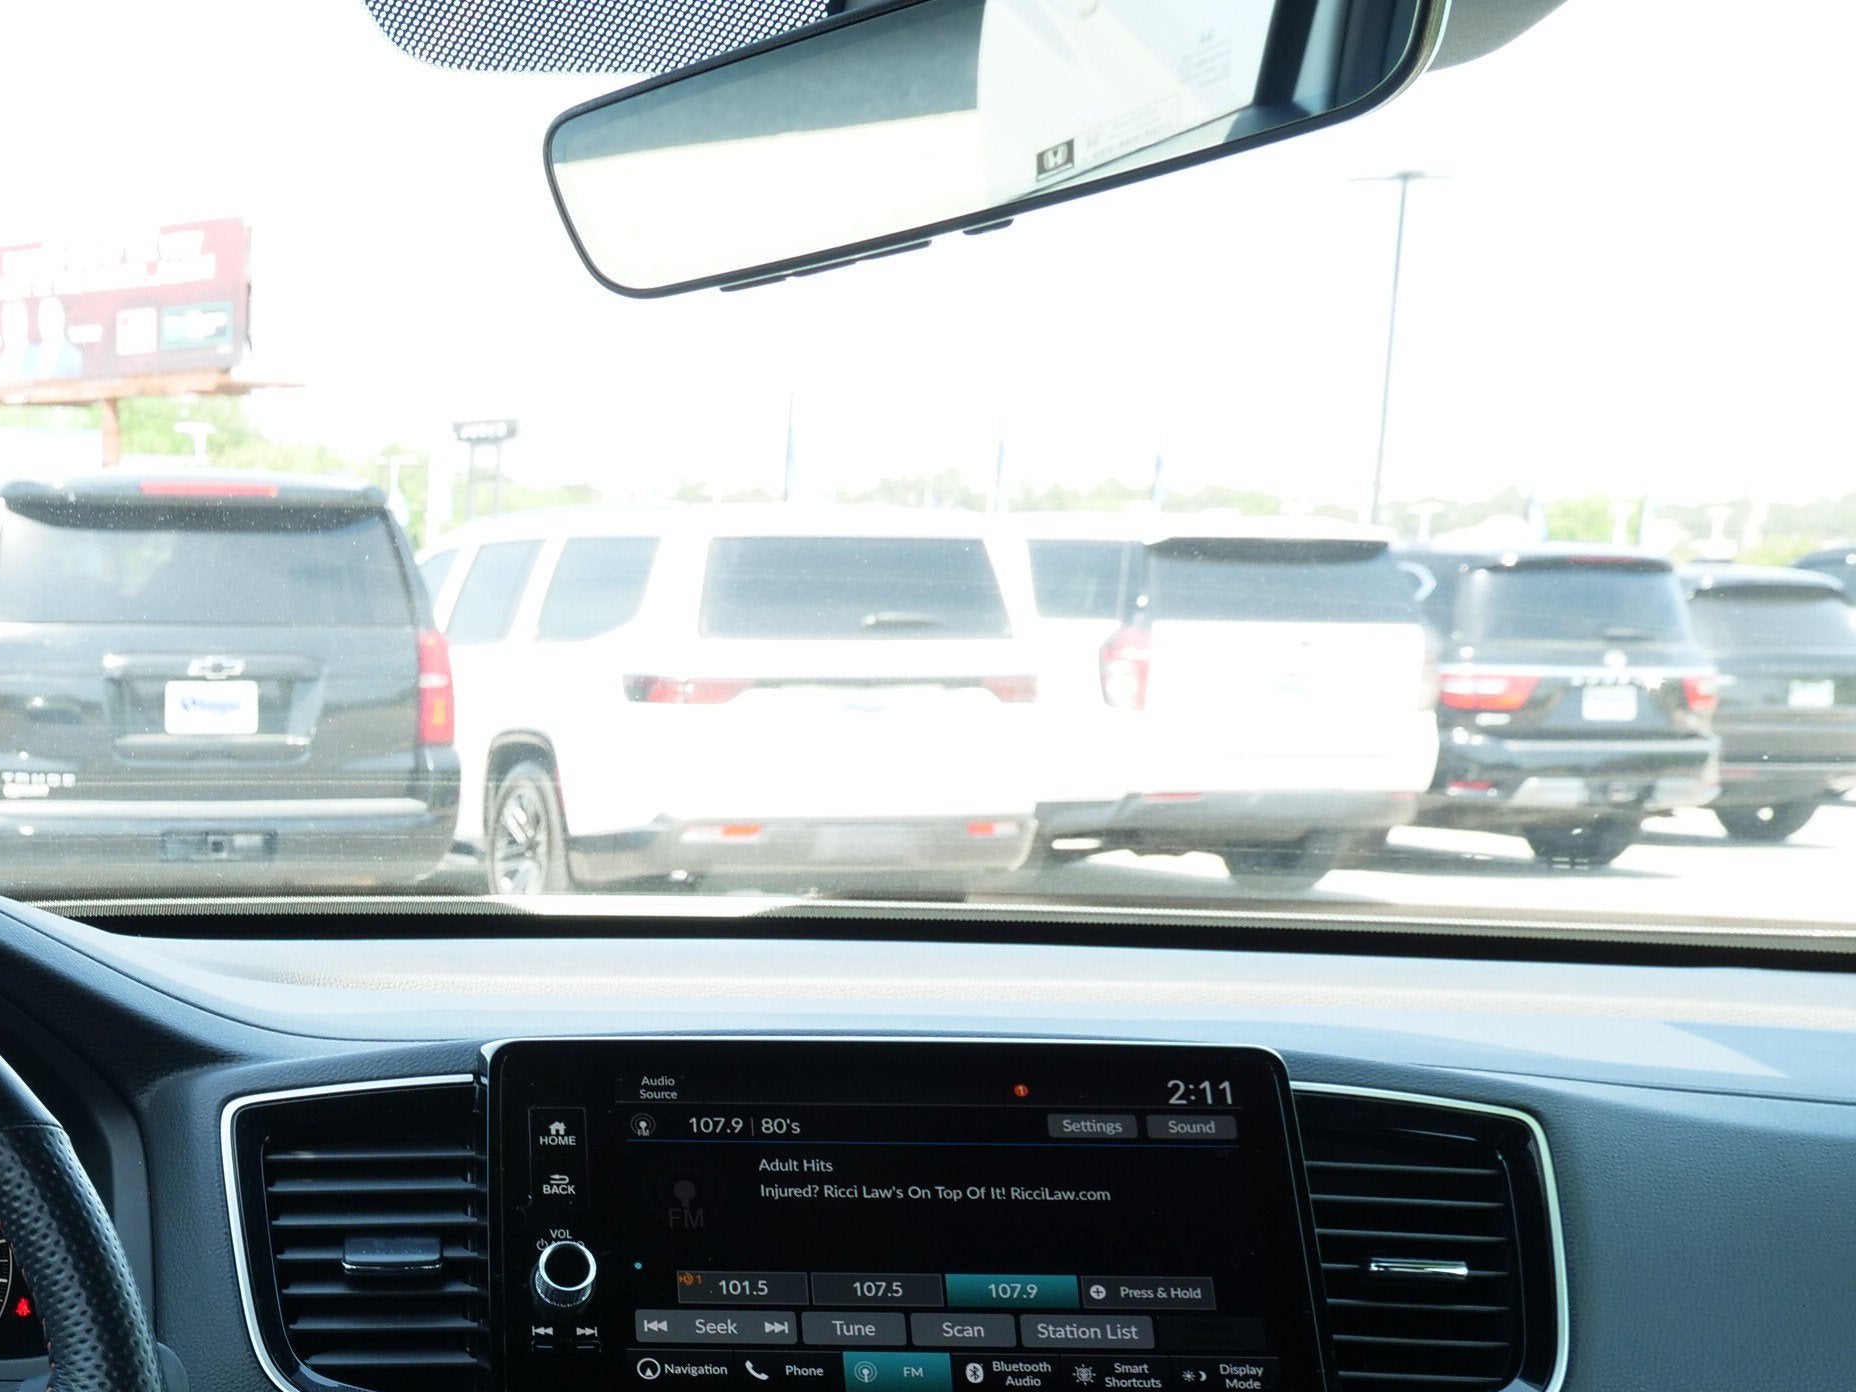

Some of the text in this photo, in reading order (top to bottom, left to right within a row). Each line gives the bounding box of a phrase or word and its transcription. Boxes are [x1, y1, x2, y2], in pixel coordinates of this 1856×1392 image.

[641, 1076, 675, 1087] Audio
[639, 1089, 678, 1100] Source
[1167, 1079, 1233, 1105] 2:11
[688, 1118, 801, 1134] 107.9 80's
[1062, 1119, 1123, 1135] Settings
[1168, 1119, 1215, 1135] Sound
[539, 1136, 576, 1146] HOME
[758, 1159, 833, 1173] Adult Hits
[543, 1185, 576, 1195] BACK
[760, 1184, 1111, 1203] Injured? Ricci Law's On Top Of It! RicciLaw.com
[669, 1209, 705, 1228] FM
[549, 1229, 573, 1240] VOL
[718, 1280, 769, 1296] 101.5
[853, 1282, 903, 1297] 107.5
[987, 1283, 1038, 1299] 107.9
[1120, 1286, 1202, 1299] Press & Hold
[695, 1318, 738, 1335] Seek
[831, 1320, 876, 1336] Tune
[942, 1323, 985, 1338] Scan
[1037, 1323, 1139, 1340] Station List
[664, 1363, 728, 1377] Navigation
[785, 1365, 824, 1377] Phone
[903, 1367, 924, 1378] FM
[992, 1361, 1052, 1374] Bluetooth
[1114, 1363, 1149, 1375] Smart
[1219, 1364, 1264, 1379] Display
[1005, 1375, 1042, 1388] Audio
[1105, 1377, 1162, 1389] Shortcuts
[1225, 1378, 1262, 1391] Mode
